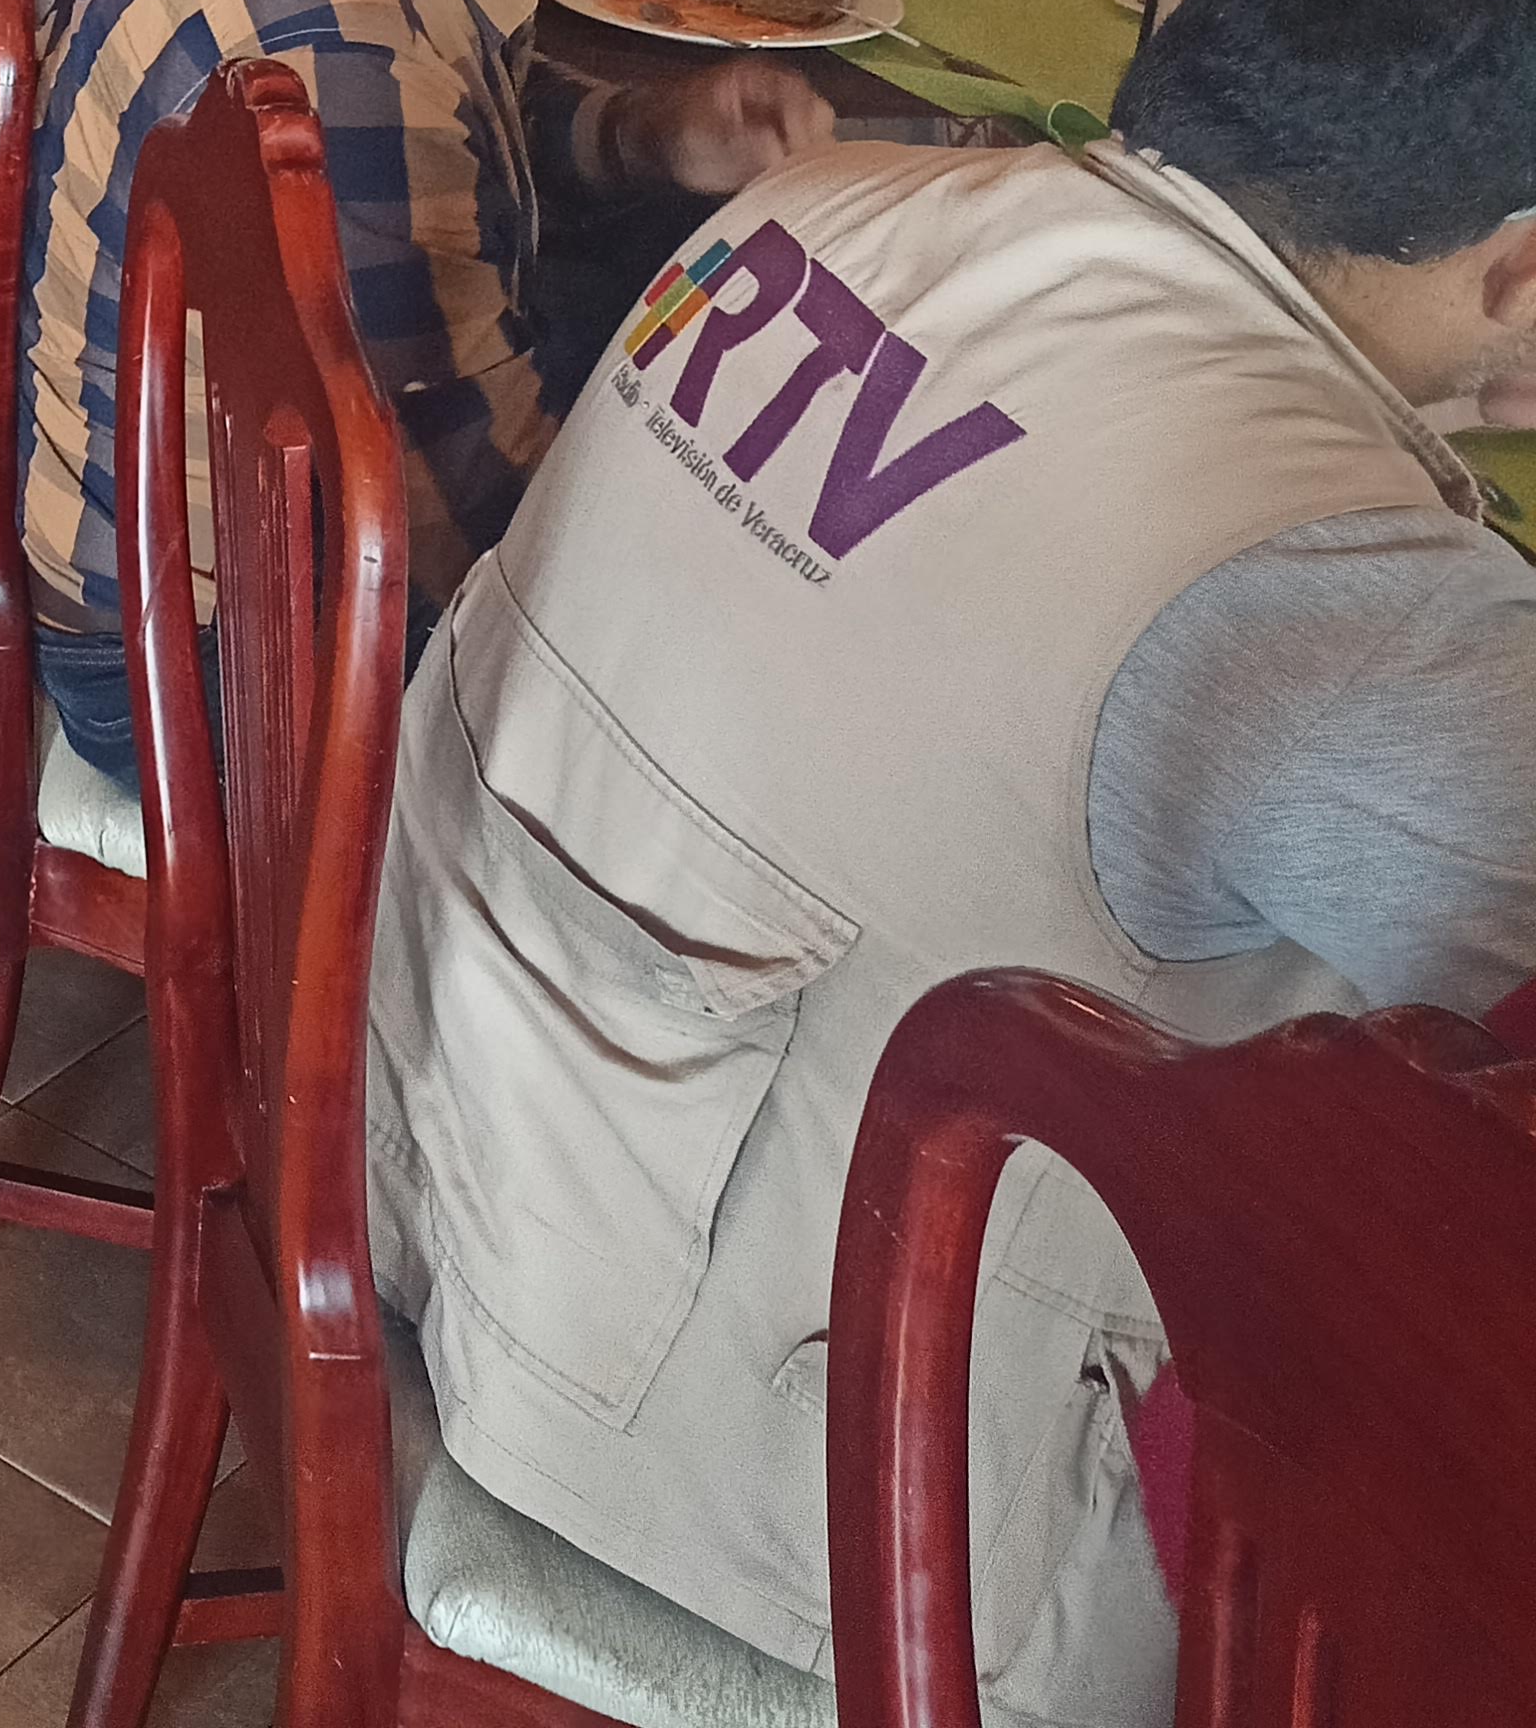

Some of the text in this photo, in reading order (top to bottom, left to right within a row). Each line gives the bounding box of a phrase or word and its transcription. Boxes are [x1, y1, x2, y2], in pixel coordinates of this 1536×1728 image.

[625, 219, 1027, 560] RTV
[714, 483, 743, 513] de
[741, 501, 833, 588] Veracruz
